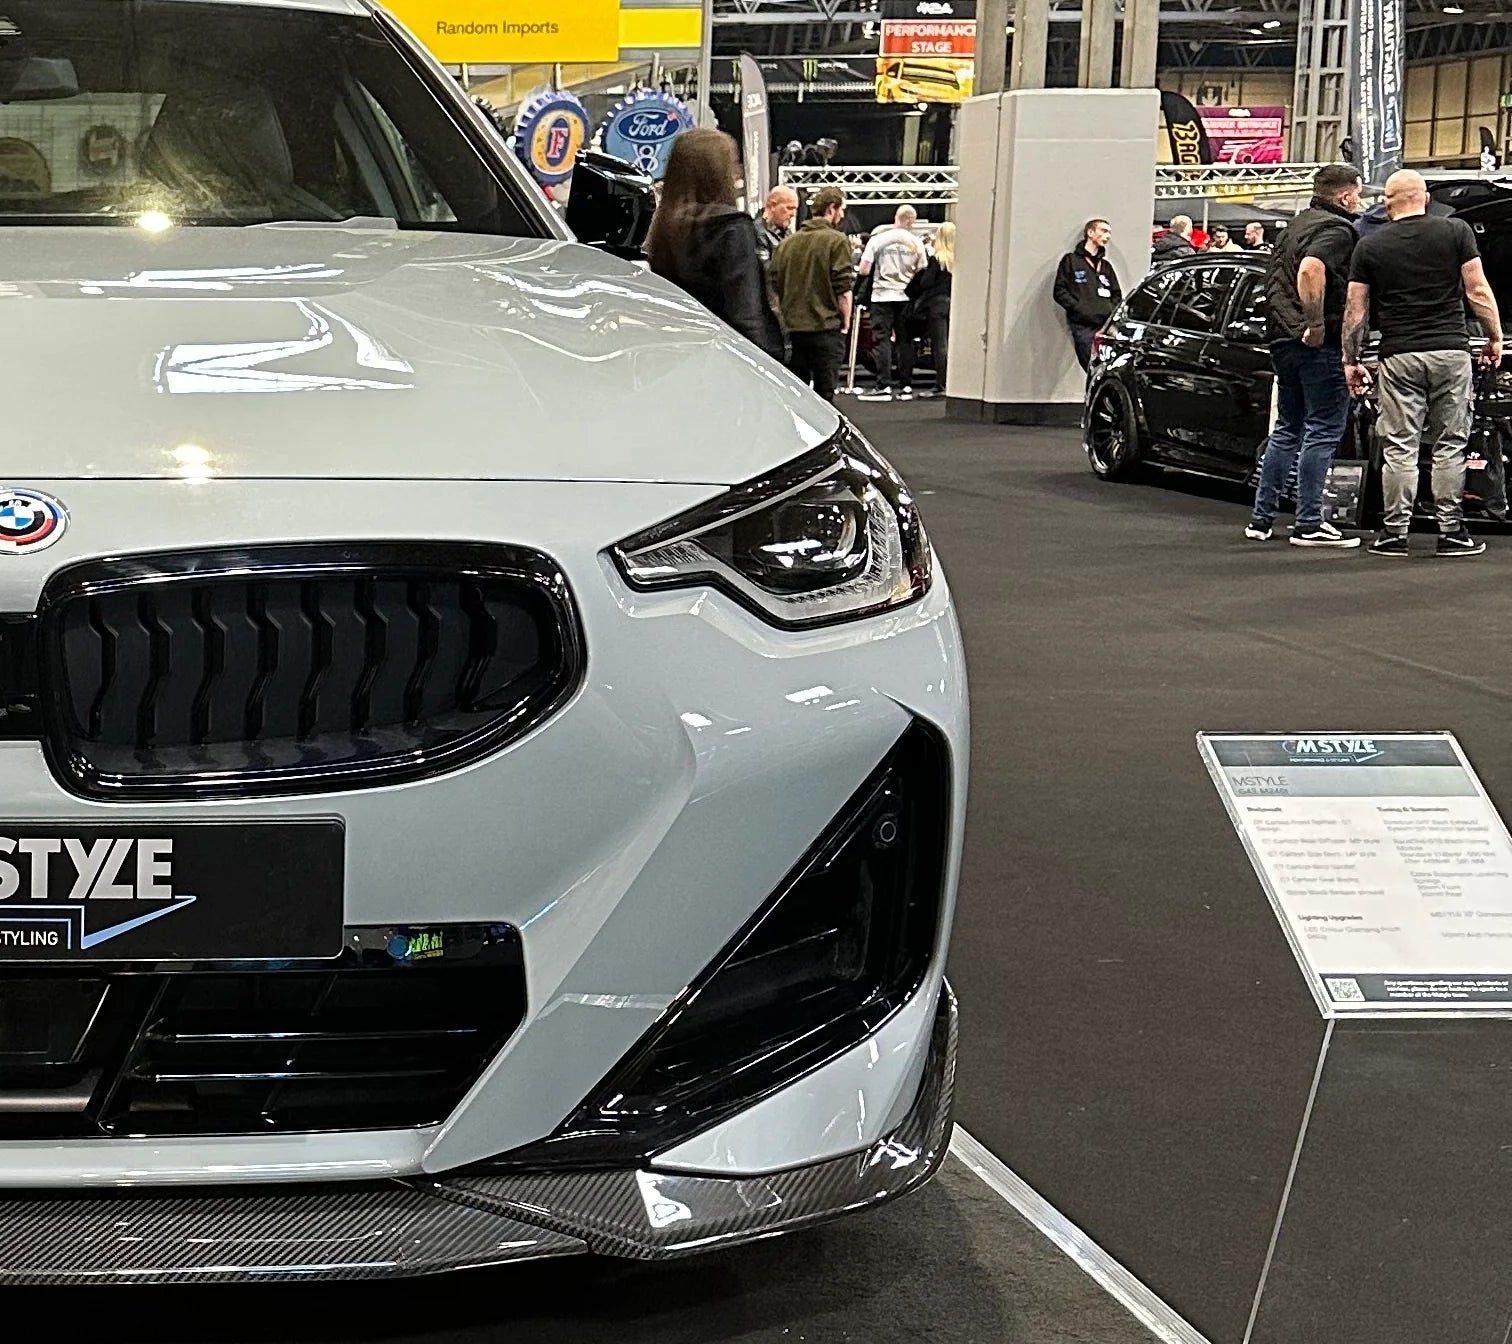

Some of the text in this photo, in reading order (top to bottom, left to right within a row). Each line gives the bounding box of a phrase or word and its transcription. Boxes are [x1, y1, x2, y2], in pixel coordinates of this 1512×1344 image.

[436, 20, 559, 39] Random Imports
[885, 24, 977, 37] PERFORMANC
[911, 41, 953, 53] STAGE
[628, 113, 667, 137] Ford
[546, 127, 569, 158] F
[1232, 776, 1288, 787] MSTYLE
